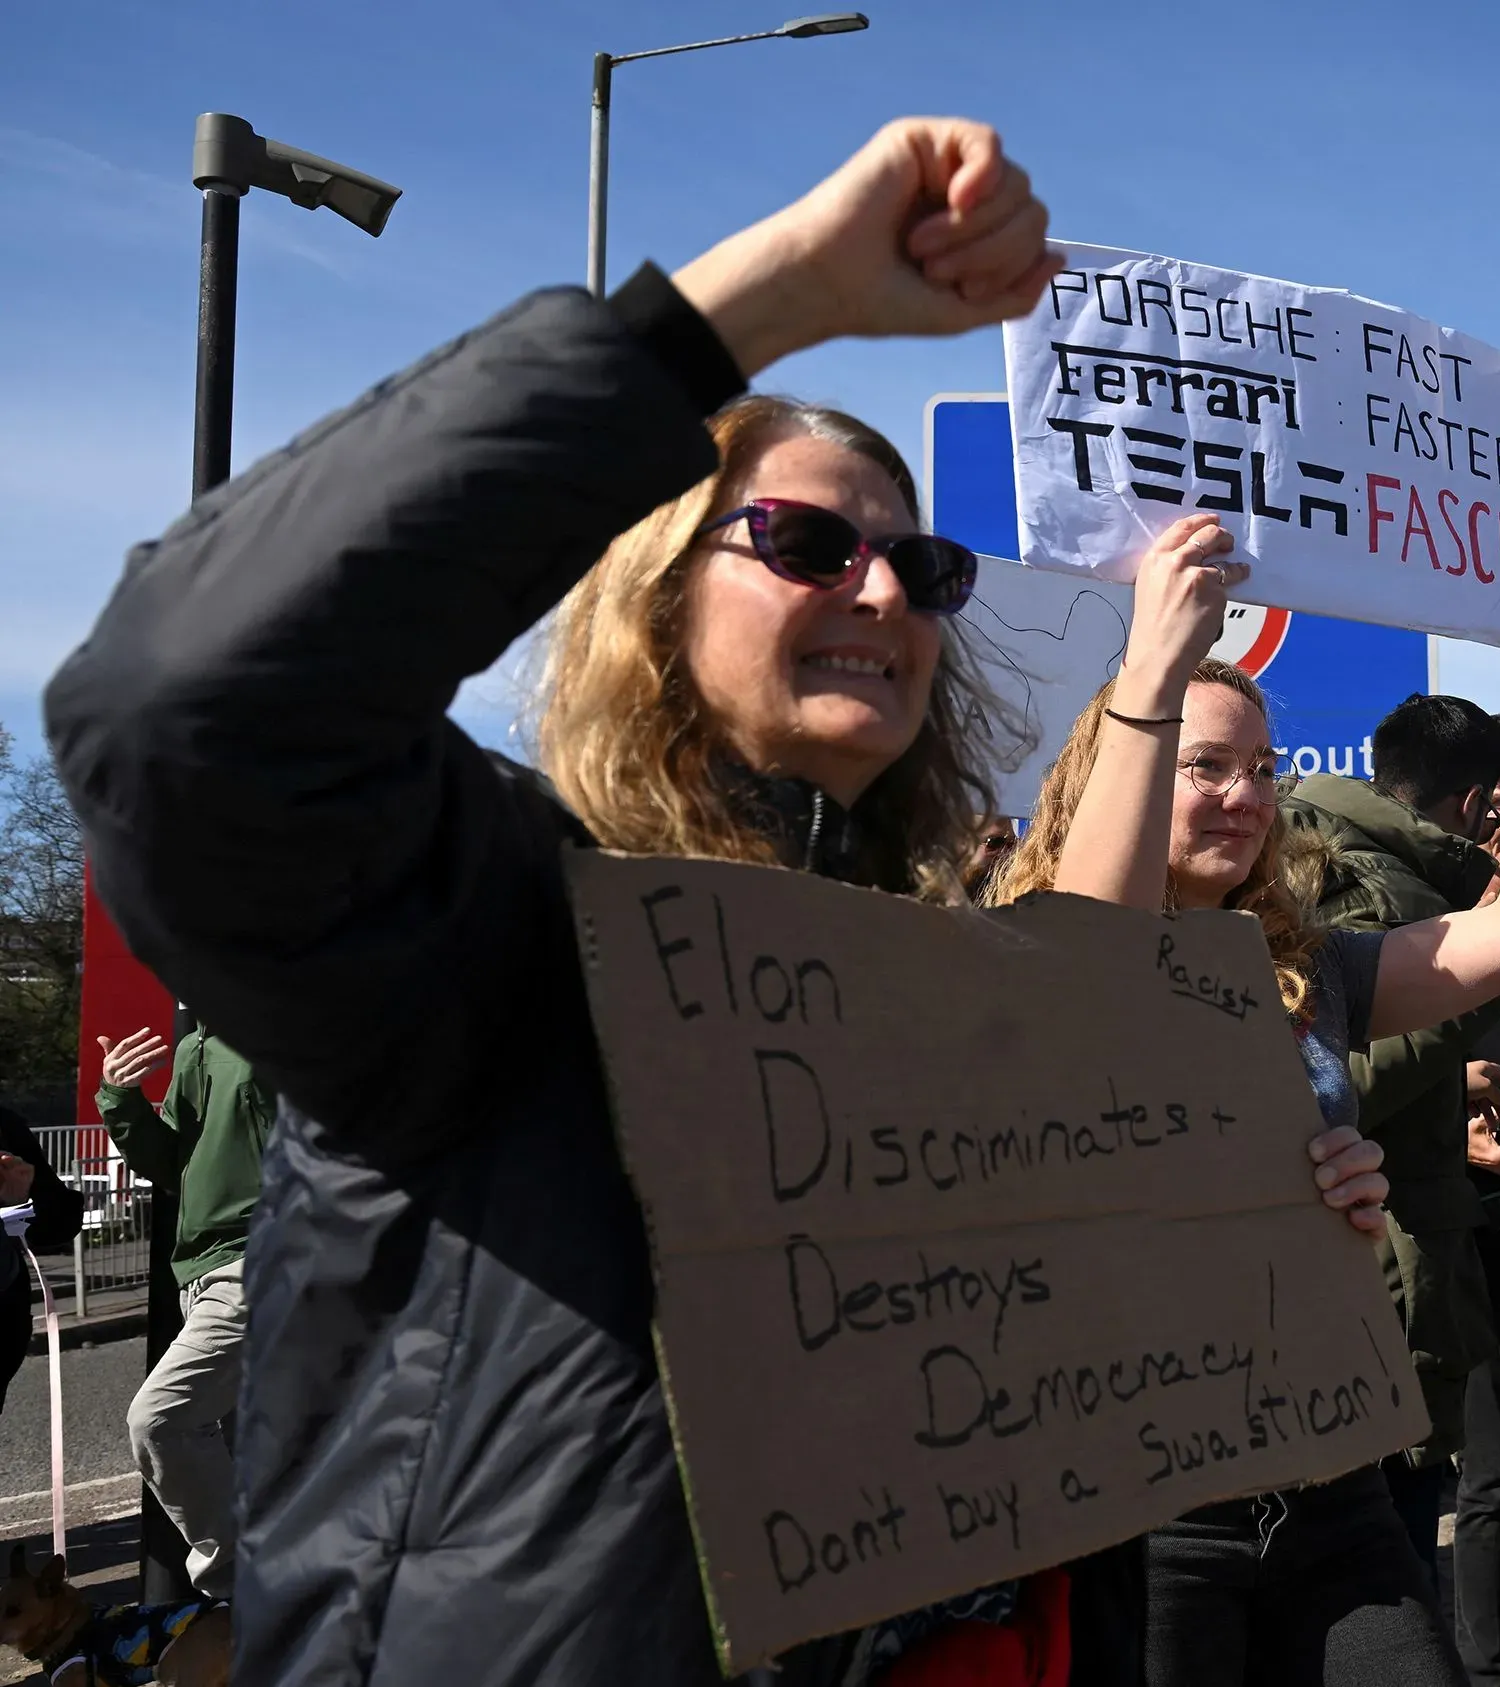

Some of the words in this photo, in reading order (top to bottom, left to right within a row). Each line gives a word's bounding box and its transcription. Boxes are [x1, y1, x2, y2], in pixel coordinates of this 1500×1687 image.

[1051, 271, 1317, 361] PORSCHE
[1363, 323, 1472, 402] FAST
[1051, 342, 1300, 430] Ferrari
[639, 885, 844, 1026] Elon
[1157, 933, 1259, 1021] Racist
[755, 1049, 1190, 1203] Discriminates
[786, 1234, 1051, 1353] Destroys
[914, 1261, 1279, 1449] Democracy!
[763, 1486, 906, 1594] Don't
[937, 1477, 1020, 1550] buy
[1060, 1463, 1099, 1504] a
